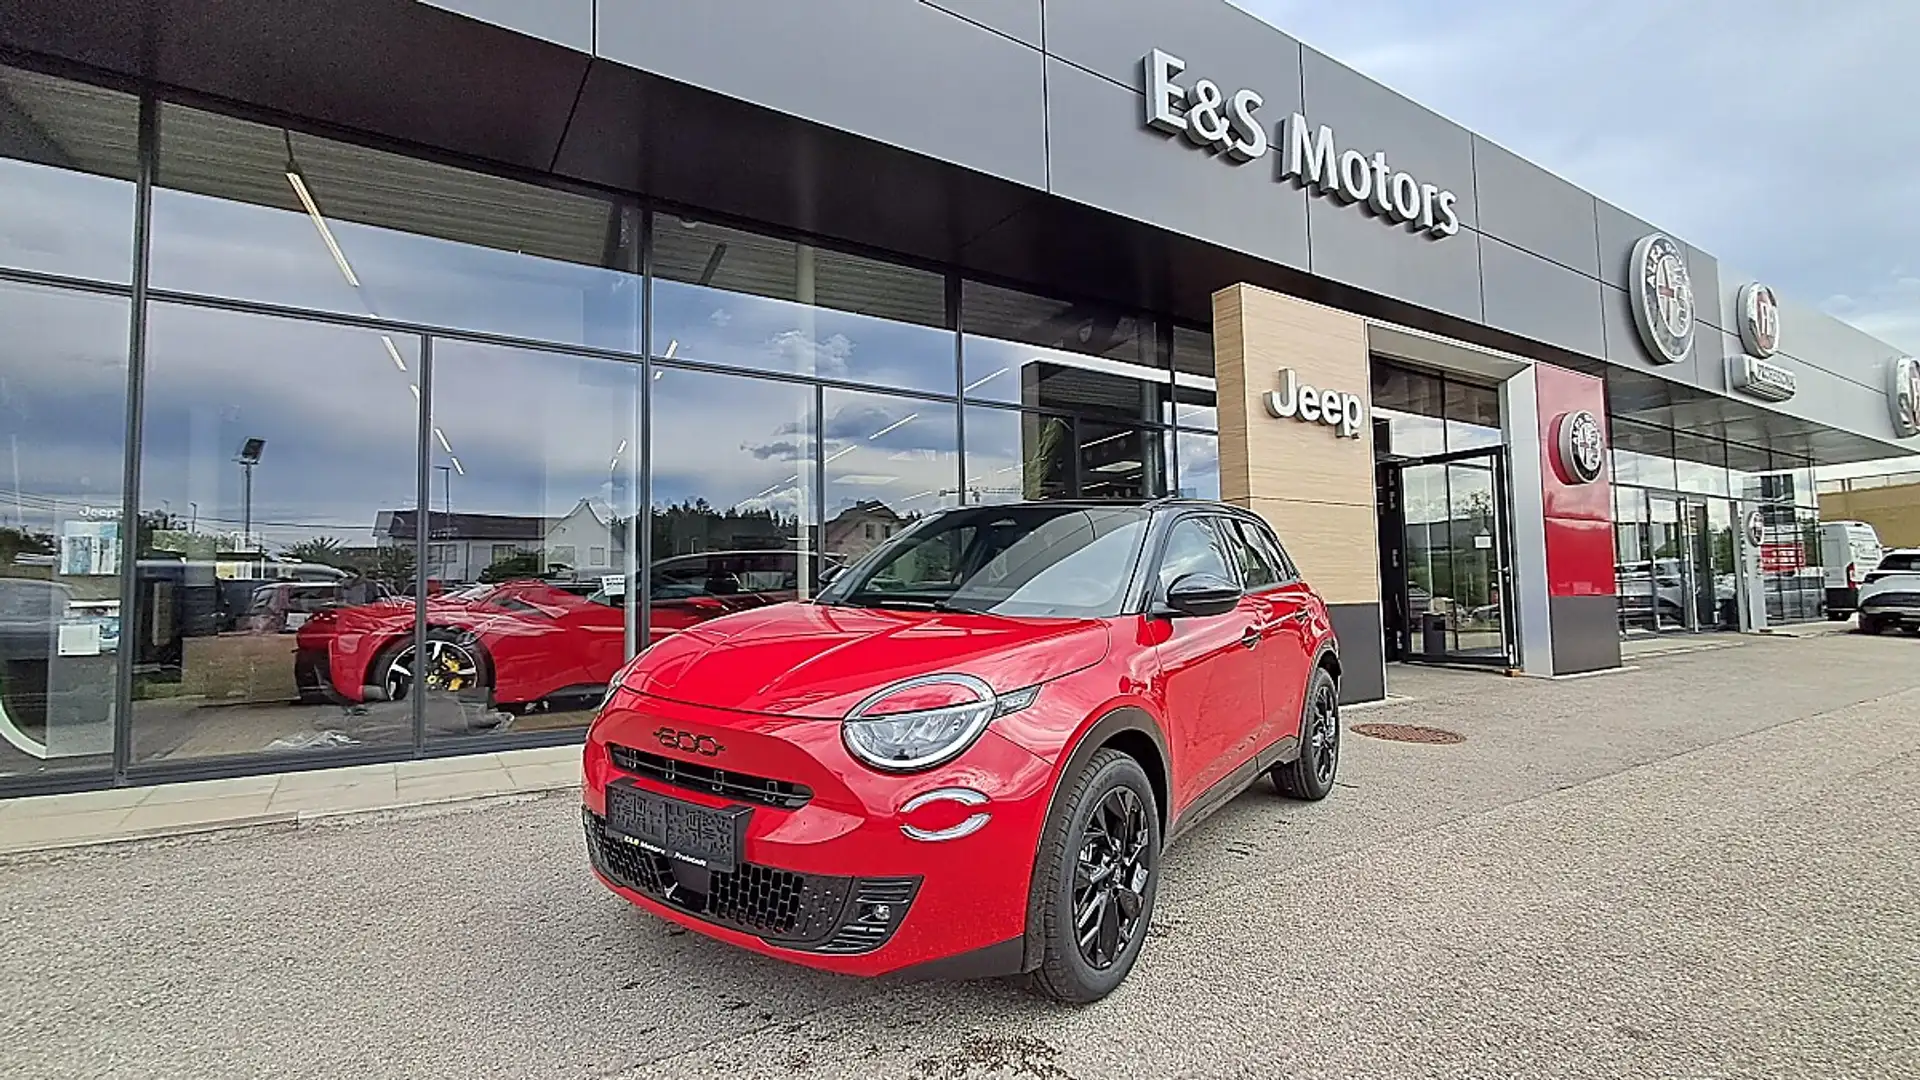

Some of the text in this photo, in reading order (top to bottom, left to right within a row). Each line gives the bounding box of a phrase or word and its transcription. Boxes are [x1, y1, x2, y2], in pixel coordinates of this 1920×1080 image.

[1147, 48, 1459, 236] E&S Motors
[1266, 368, 1363, 437] Jeep
[653, 727, 726, 756] 600
